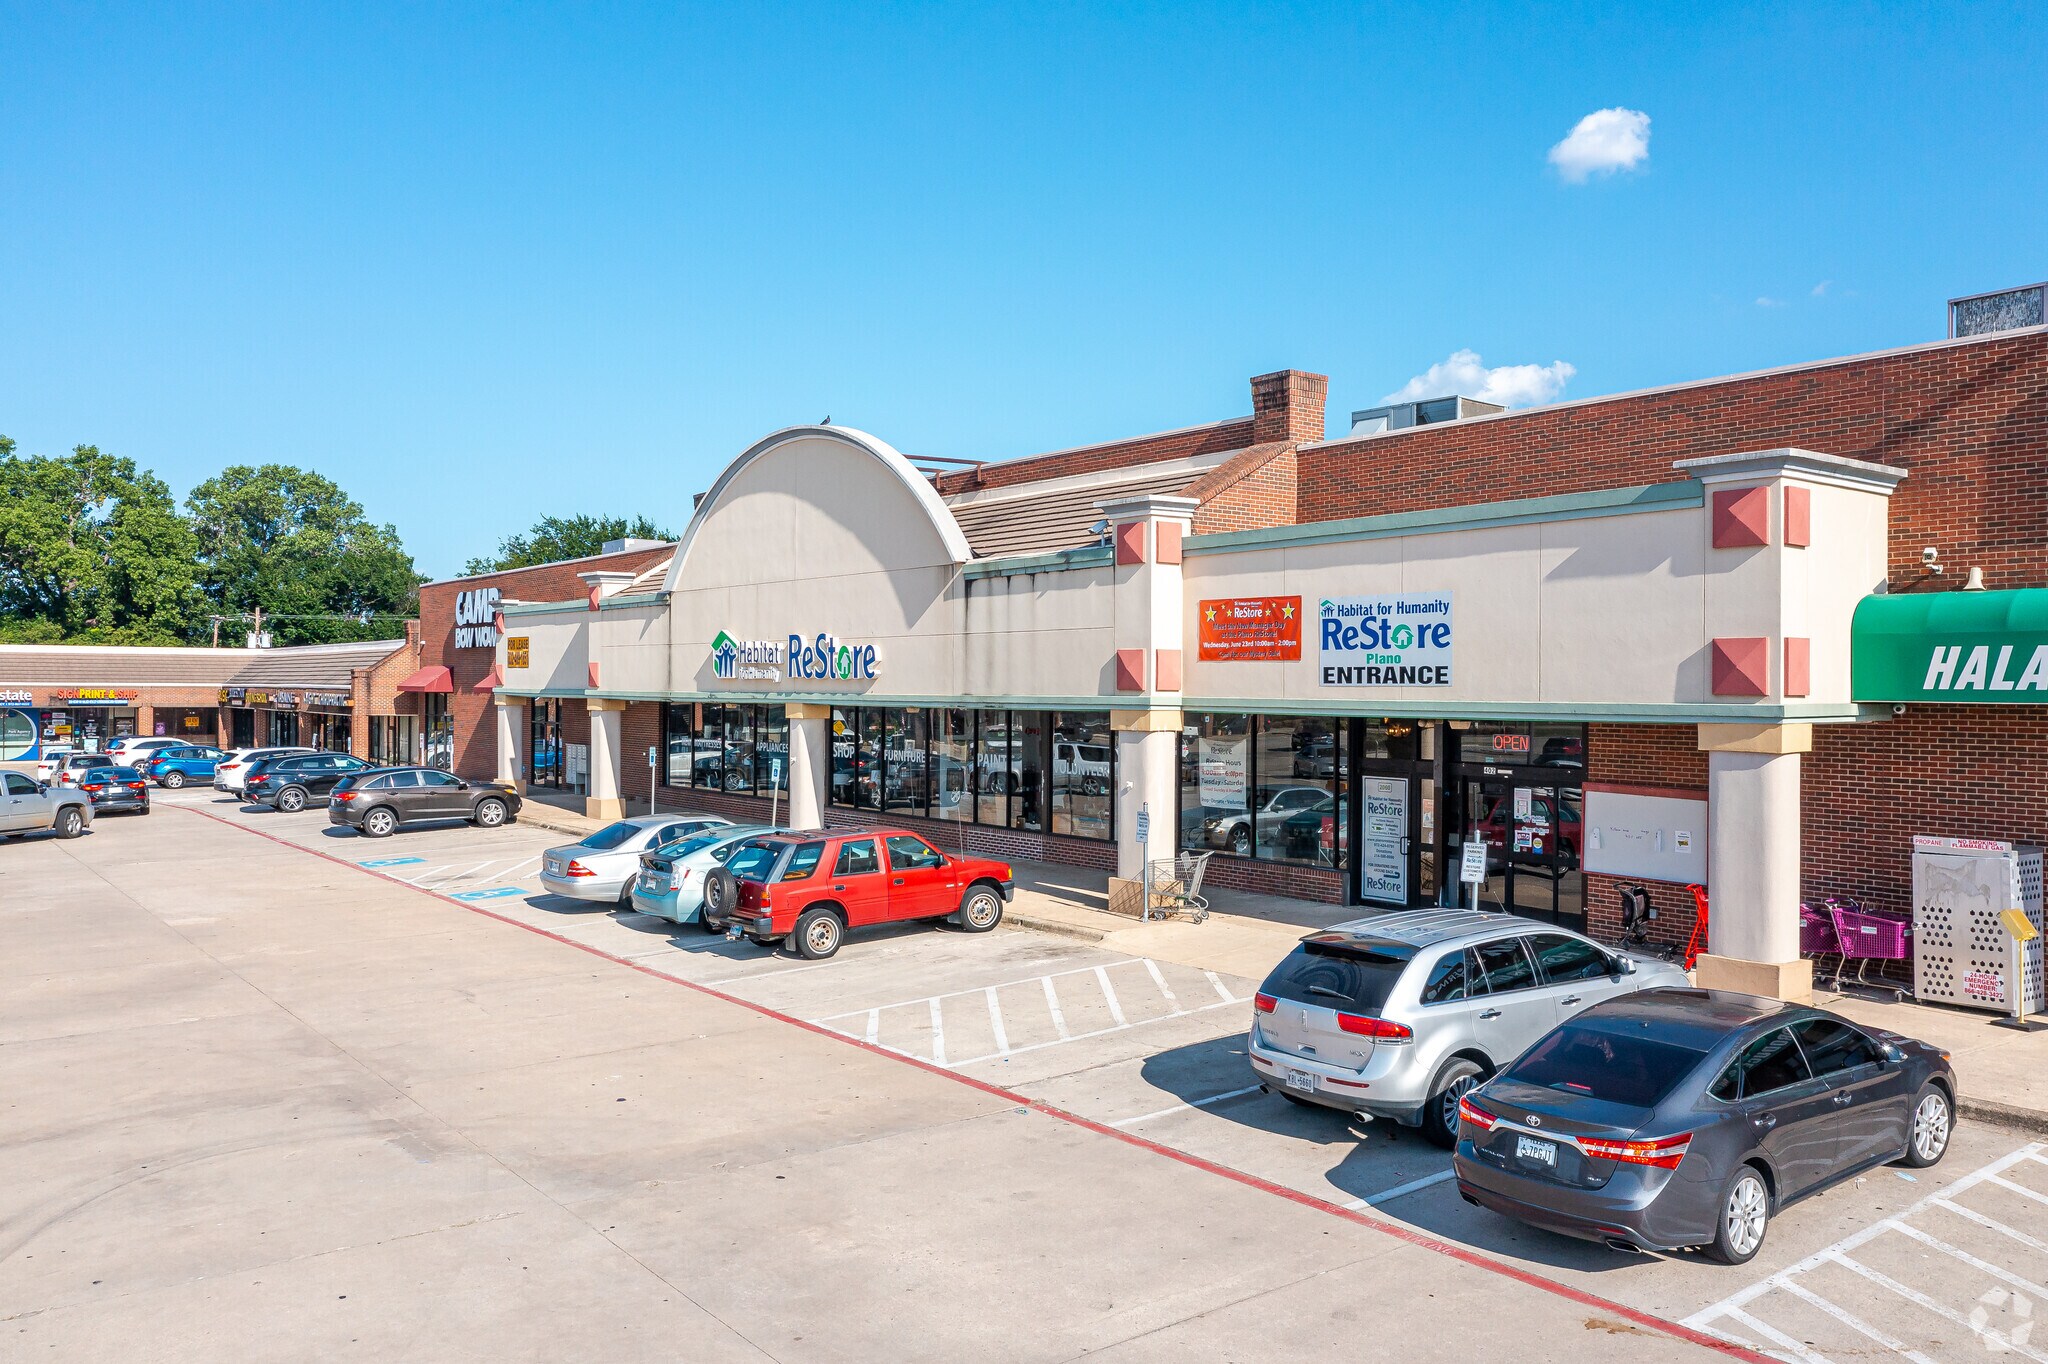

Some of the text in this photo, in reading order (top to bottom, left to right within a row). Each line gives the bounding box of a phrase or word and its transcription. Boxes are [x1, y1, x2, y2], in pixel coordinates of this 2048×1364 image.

[456, 588, 500, 626] CAMP
[1234, 607, 1262, 618] ReStore
[1337, 599, 1450, 617] Habitat for Humanity
[1249, 621, 1274, 631] Manager
[1275, 620, 1285, 631] Day
[455, 626, 497, 649] BOW WOW
[1322, 615, 1451, 651] ReStore
[1203, 641, 1230, 650] Wednesday,
[1242, 640, 1254, 648] 23rd
[1254, 639, 1275, 647] 10:00am
[1278, 639, 1297, 648] 2:00pm
[739, 641, 780, 664] Habitat
[788, 633, 877, 680] ReStore
[1366, 653, 1402, 665] Plano
[1922, 645, 2048, 690] HALA
[1323, 665, 1449, 685] ENTRANCE
[108, 689, 116, 699] &
[117, 689, 138, 700] SHIP
[756, 742, 789, 753] APPLIANCES
[1494, 735, 1529, 750] OPEN
[833, 745, 855, 758] SHOP
[884, 749, 926, 763] FURNITURE
[977, 753, 1008, 768] PAINT
[1054, 762, 1110, 777] VOLUNTEER
[1484, 767, 1496, 775] 402
[1201, 778, 1221, 786] Tuesday
[1368, 802, 1403, 816] ReStore
[1915, 838, 1942, 846] PROPANE
[1367, 877, 1402, 892] ReStore
[1964, 977, 2003, 987] EMERGENC
